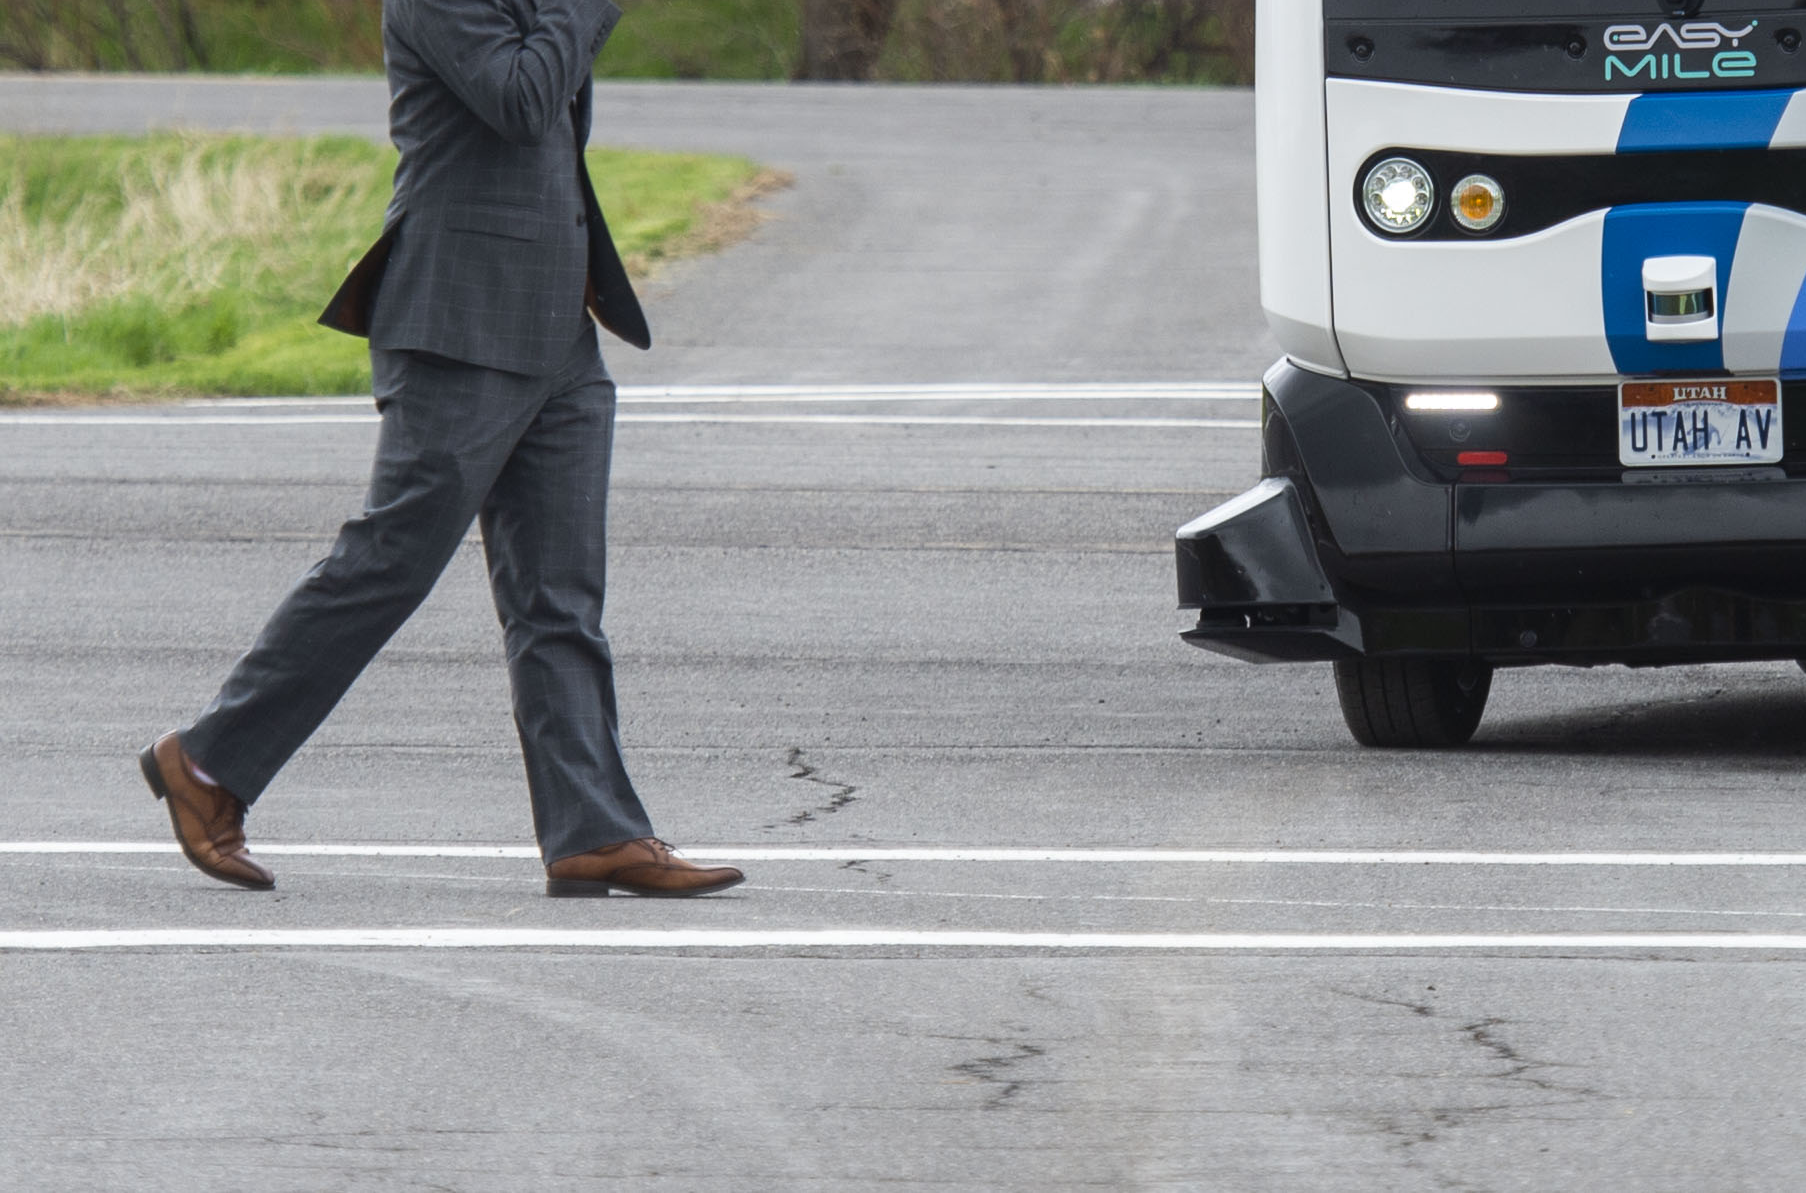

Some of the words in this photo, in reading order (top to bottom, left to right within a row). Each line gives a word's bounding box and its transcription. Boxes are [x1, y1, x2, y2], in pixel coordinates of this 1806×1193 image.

[1673, 386, 1727, 401] UTAH
[1631, 410, 1709, 452] UTAH
[1736, 408, 1771, 450] AV
